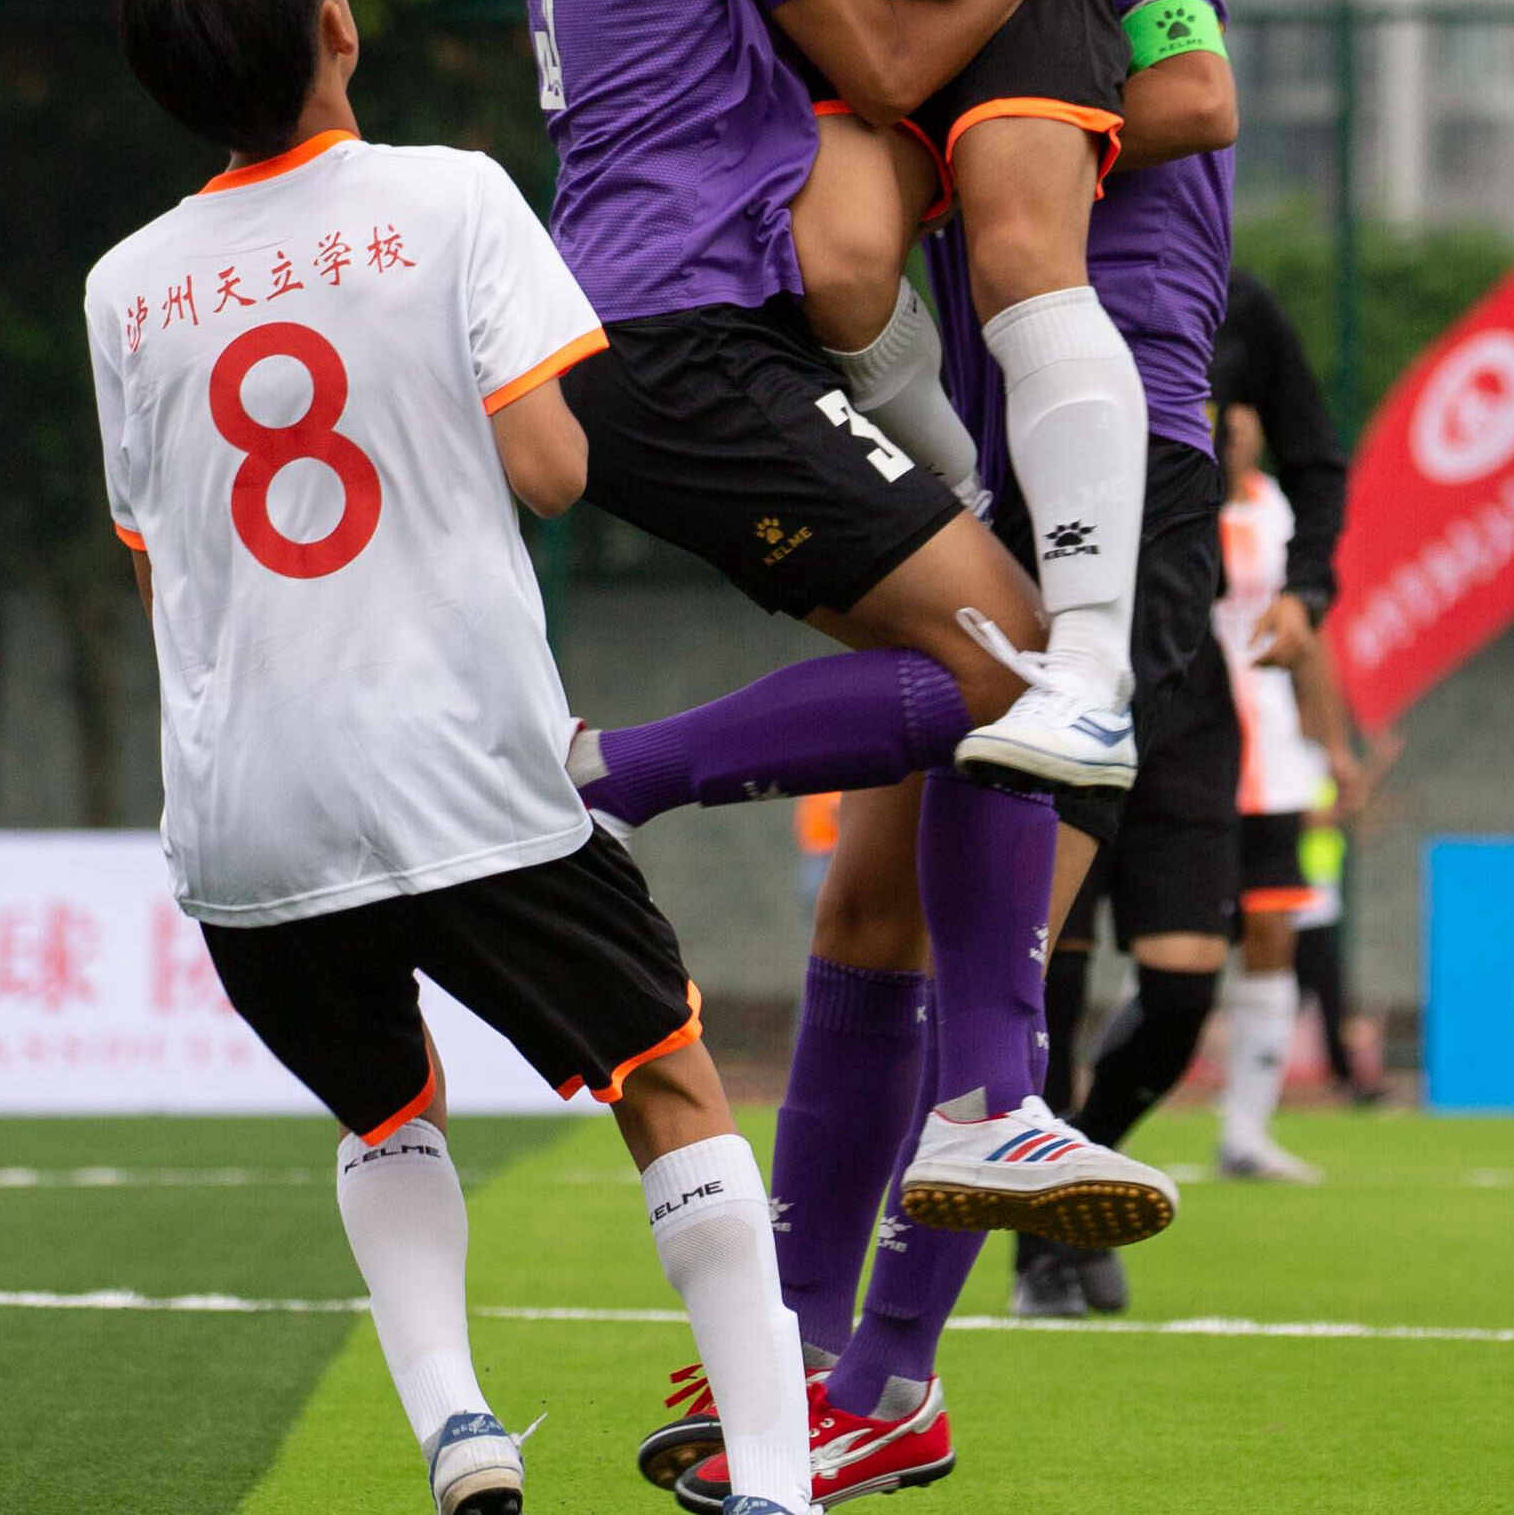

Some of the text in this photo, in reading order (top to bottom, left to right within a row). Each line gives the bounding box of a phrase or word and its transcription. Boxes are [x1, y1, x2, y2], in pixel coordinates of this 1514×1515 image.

[127, 224, 417, 353] 泸州天立学校
[209, 322, 382, 579] 8
[814, 389, 915, 484] 3
[762, 526, 813, 566] KELME
[1043, 544, 1101, 561] KELME
